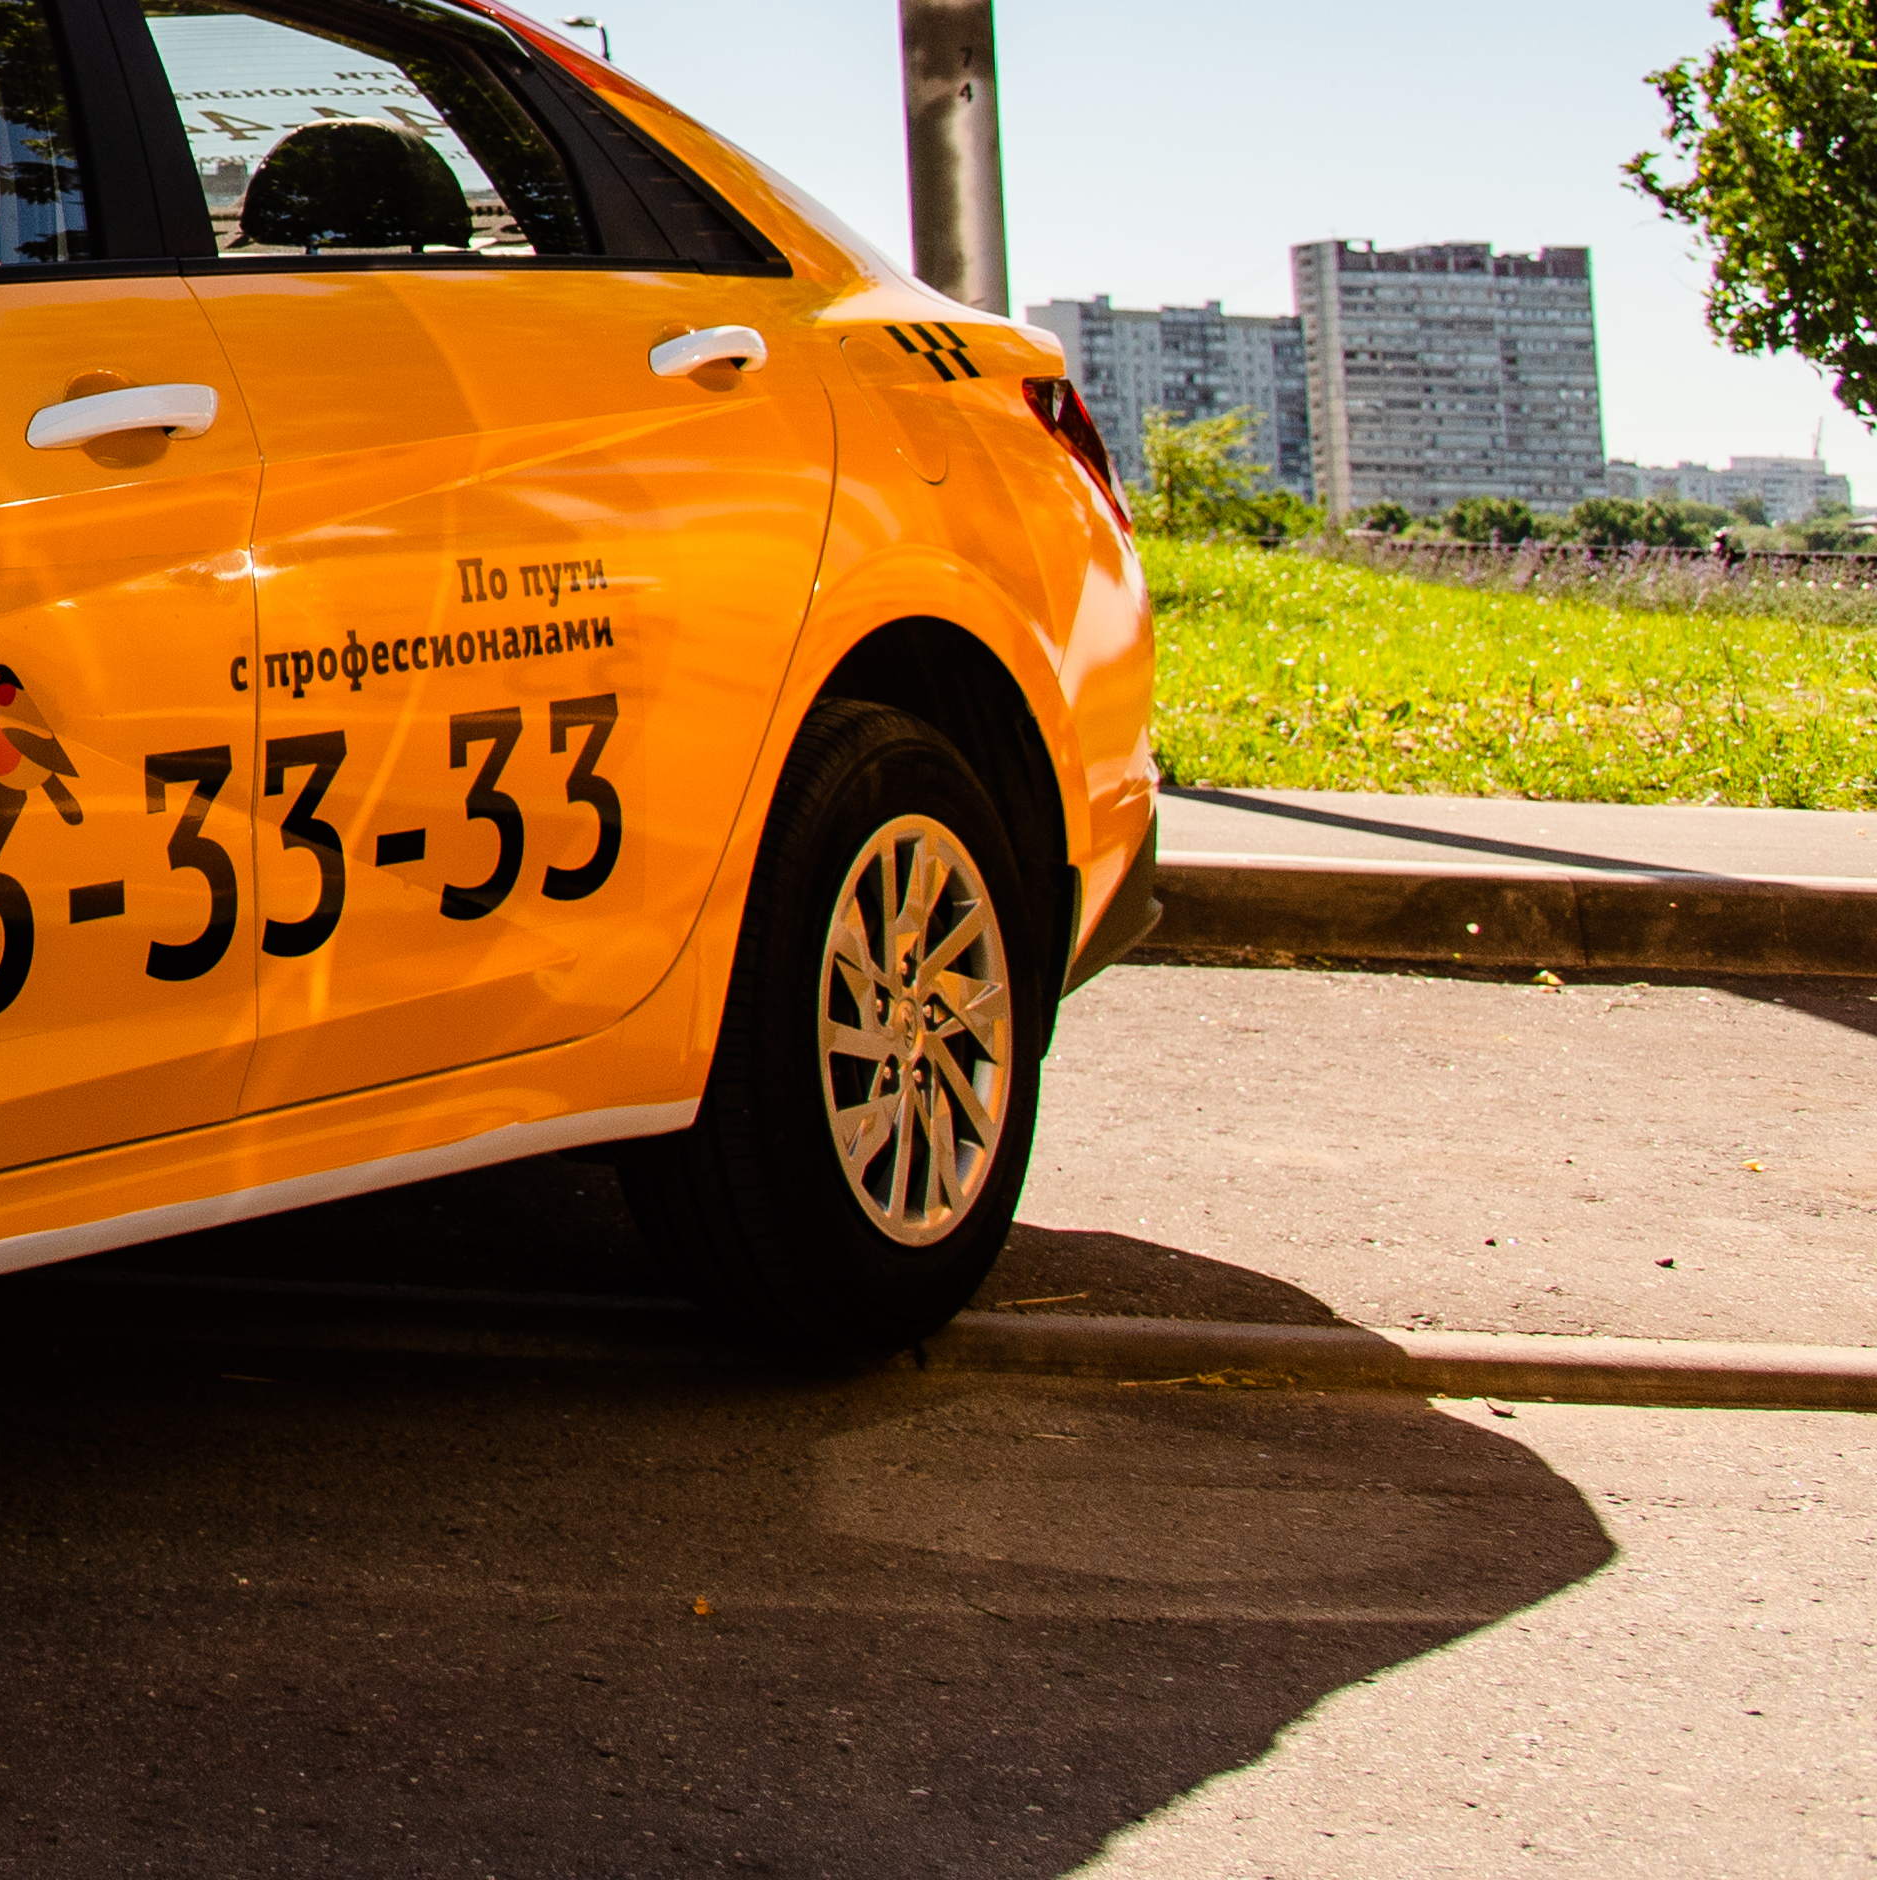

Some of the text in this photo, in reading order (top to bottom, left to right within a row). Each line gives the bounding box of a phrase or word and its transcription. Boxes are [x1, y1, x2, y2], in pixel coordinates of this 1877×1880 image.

[456, 557, 609, 607] По пути
[229, 615, 614, 699] с профессионалами
